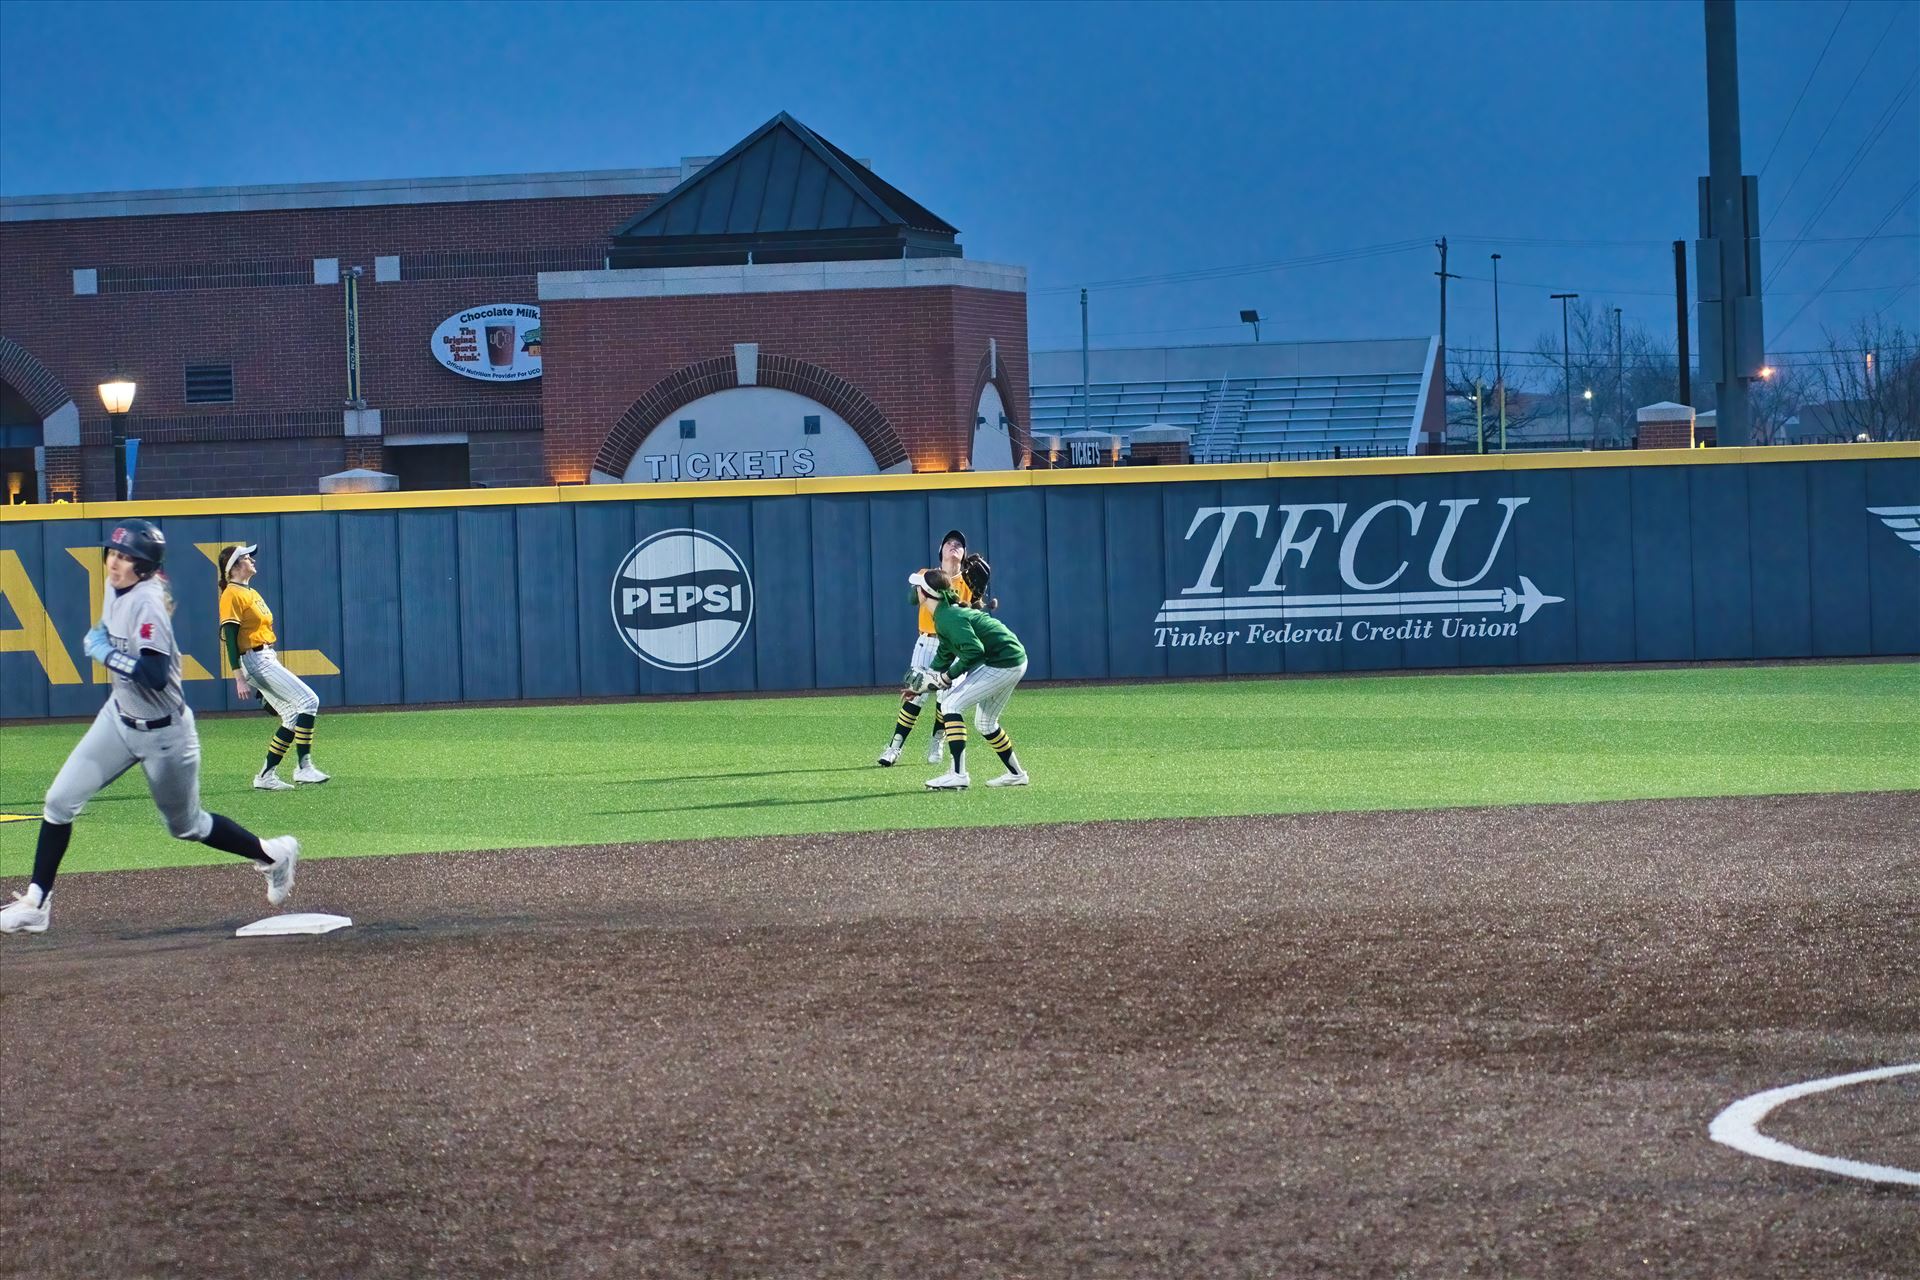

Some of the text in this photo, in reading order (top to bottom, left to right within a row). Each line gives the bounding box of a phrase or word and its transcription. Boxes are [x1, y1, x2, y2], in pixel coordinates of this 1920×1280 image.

[460, 308, 513, 323] Chocolate
[443, 336, 477, 345] Original
[459, 327, 476, 336] The
[450, 344, 477, 353] Sports
[446, 360, 465, 372] Official
[466, 368, 491, 378] Nutrition
[492, 371, 516, 379] Provider
[528, 367, 541, 376] UCO
[1070, 441, 1100, 465] TICKETS
[644, 449, 816, 480] TICKETS
[1181, 497, 1531, 595] TFCU
[622, 584, 743, 616] PEPSI
[1153, 617, 1519, 648] Tinker Federal Credit Union
